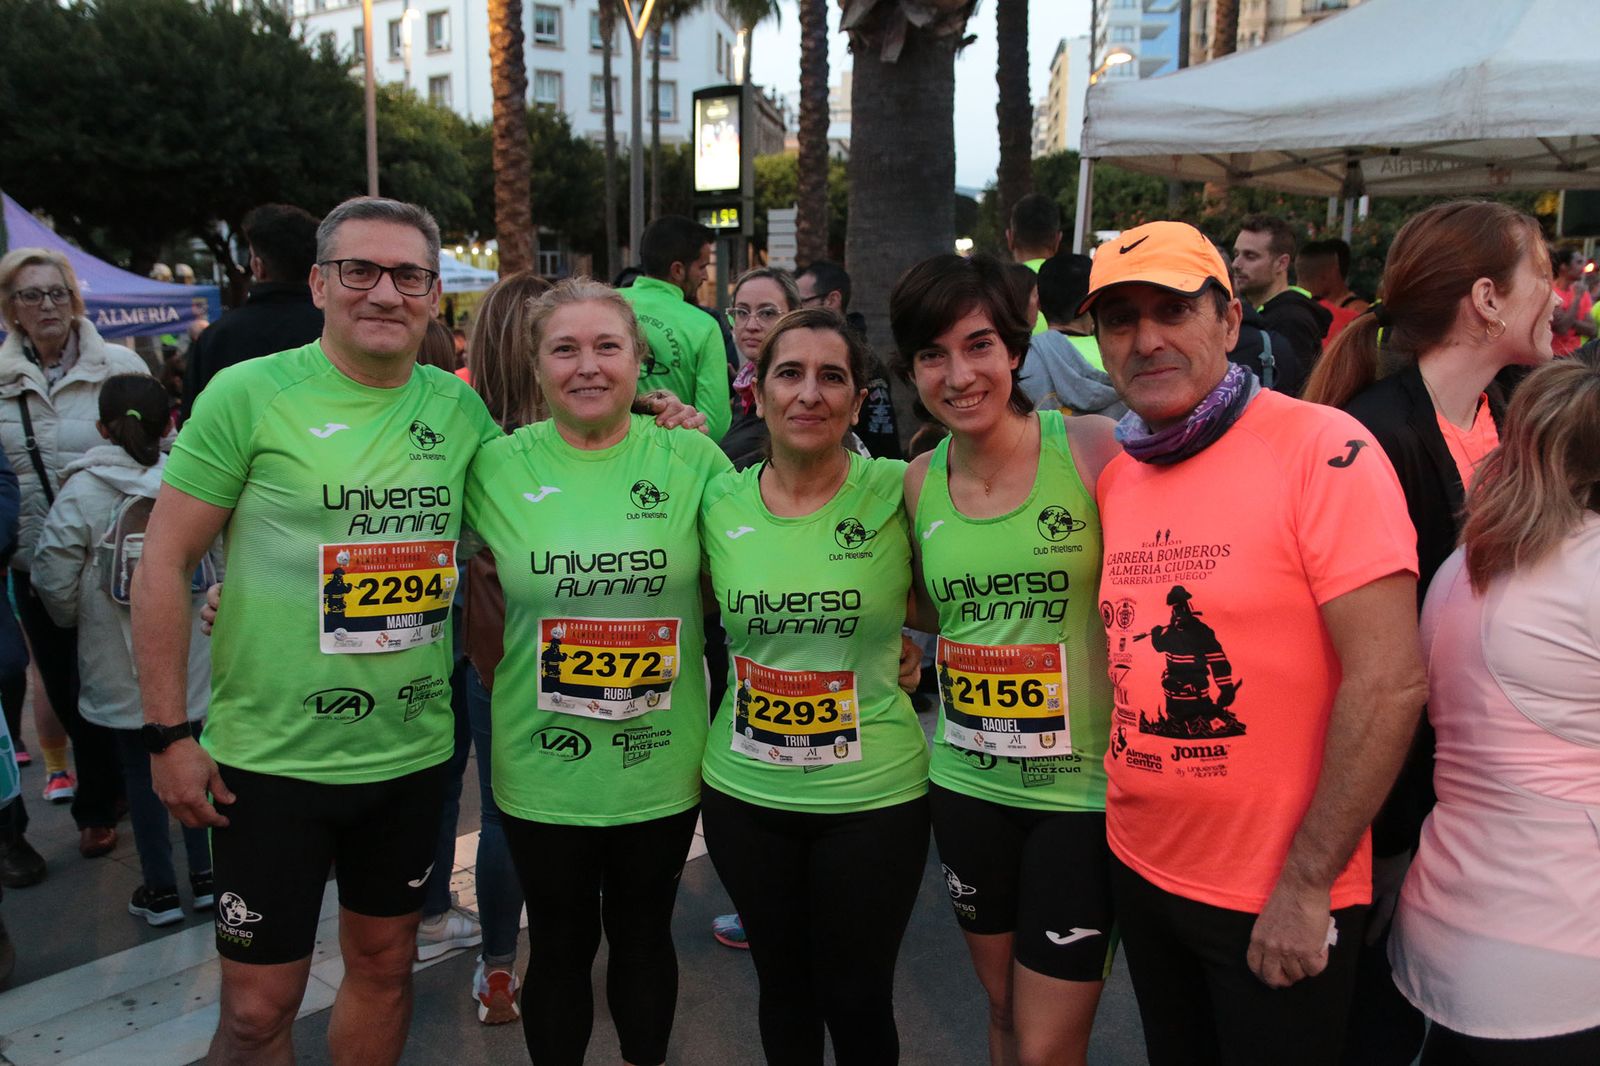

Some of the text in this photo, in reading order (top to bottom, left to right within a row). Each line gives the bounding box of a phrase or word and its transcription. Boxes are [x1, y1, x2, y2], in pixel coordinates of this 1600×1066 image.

[409, 453, 447, 461] Club Atletismo
[323, 484, 450, 511] Universo
[348, 511, 450, 536] Running
[829, 551, 873, 561] Club Atletismo
[1033, 545, 1083, 556] Club Atletismo
[1107, 544, 1231, 566] CARRERA BOMBEROS
[531, 549, 667, 575] Universo
[1109, 559, 1216, 577] ALMERIA CIUDAD
[555, 574, 667, 598] Running
[932, 570, 1069, 603] Universo
[1155, 573, 1172, 584] DEL
[358, 574, 444, 606] 2294
[727, 589, 861, 614] Universo
[961, 597, 1069, 623] Running
[386, 613, 424, 629] MANOLO
[747, 615, 860, 638] Running
[572, 650, 662, 678] 2372
[603, 687, 633, 701] RUBIA
[957, 676, 1045, 708] 2156
[754, 695, 839, 725] 2293
[982, 717, 1021, 733] RAQUEL
[784, 735, 810, 747] TRINI
[1126, 756, 1163, 770] centro
[1171, 744, 1228, 762] Joma
